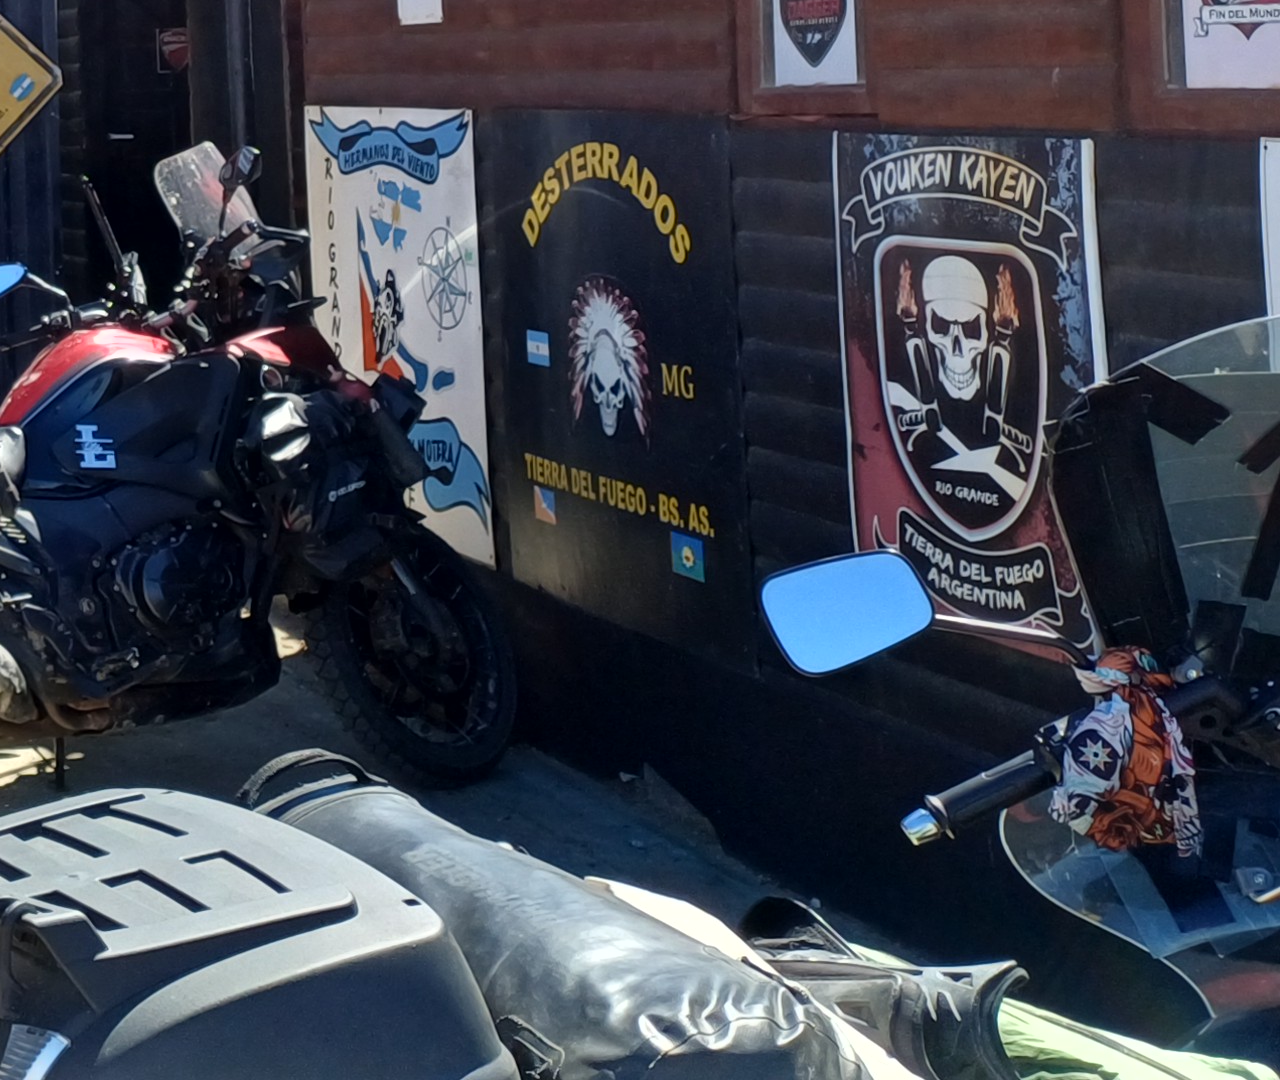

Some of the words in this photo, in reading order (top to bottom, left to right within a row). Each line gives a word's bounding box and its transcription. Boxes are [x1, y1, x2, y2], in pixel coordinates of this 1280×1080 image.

[1209, 8, 1226, 19] FIN
[1228, 9, 1247, 18] DEL
[1249, 7, 1280, 18] MUND
[344, 144, 389, 169] HERMANOS
[391, 144, 405, 163] DEL
[407, 153, 435, 179] VIENTO
[868, 152, 953, 201] VOUKEN
[959, 152, 1036, 209] KAYEN
[521, 142, 691, 264] DESTERRADOS
[327, 242, 342, 359] GRAND
[660, 362, 695, 400] MG
[523, 452, 568, 492] TIERRA
[571, 466, 596, 501] DEL
[598, 474, 647, 516] FUEGO
[935, 480, 952, 496] RIO
[954, 484, 1000, 507] GRANDE
[904, 523, 954, 575] TIERRA
[959, 560, 992, 583] DEL
[995, 558, 1045, 587] FUEGO
[927, 567, 1027, 612] ARGENTINA
